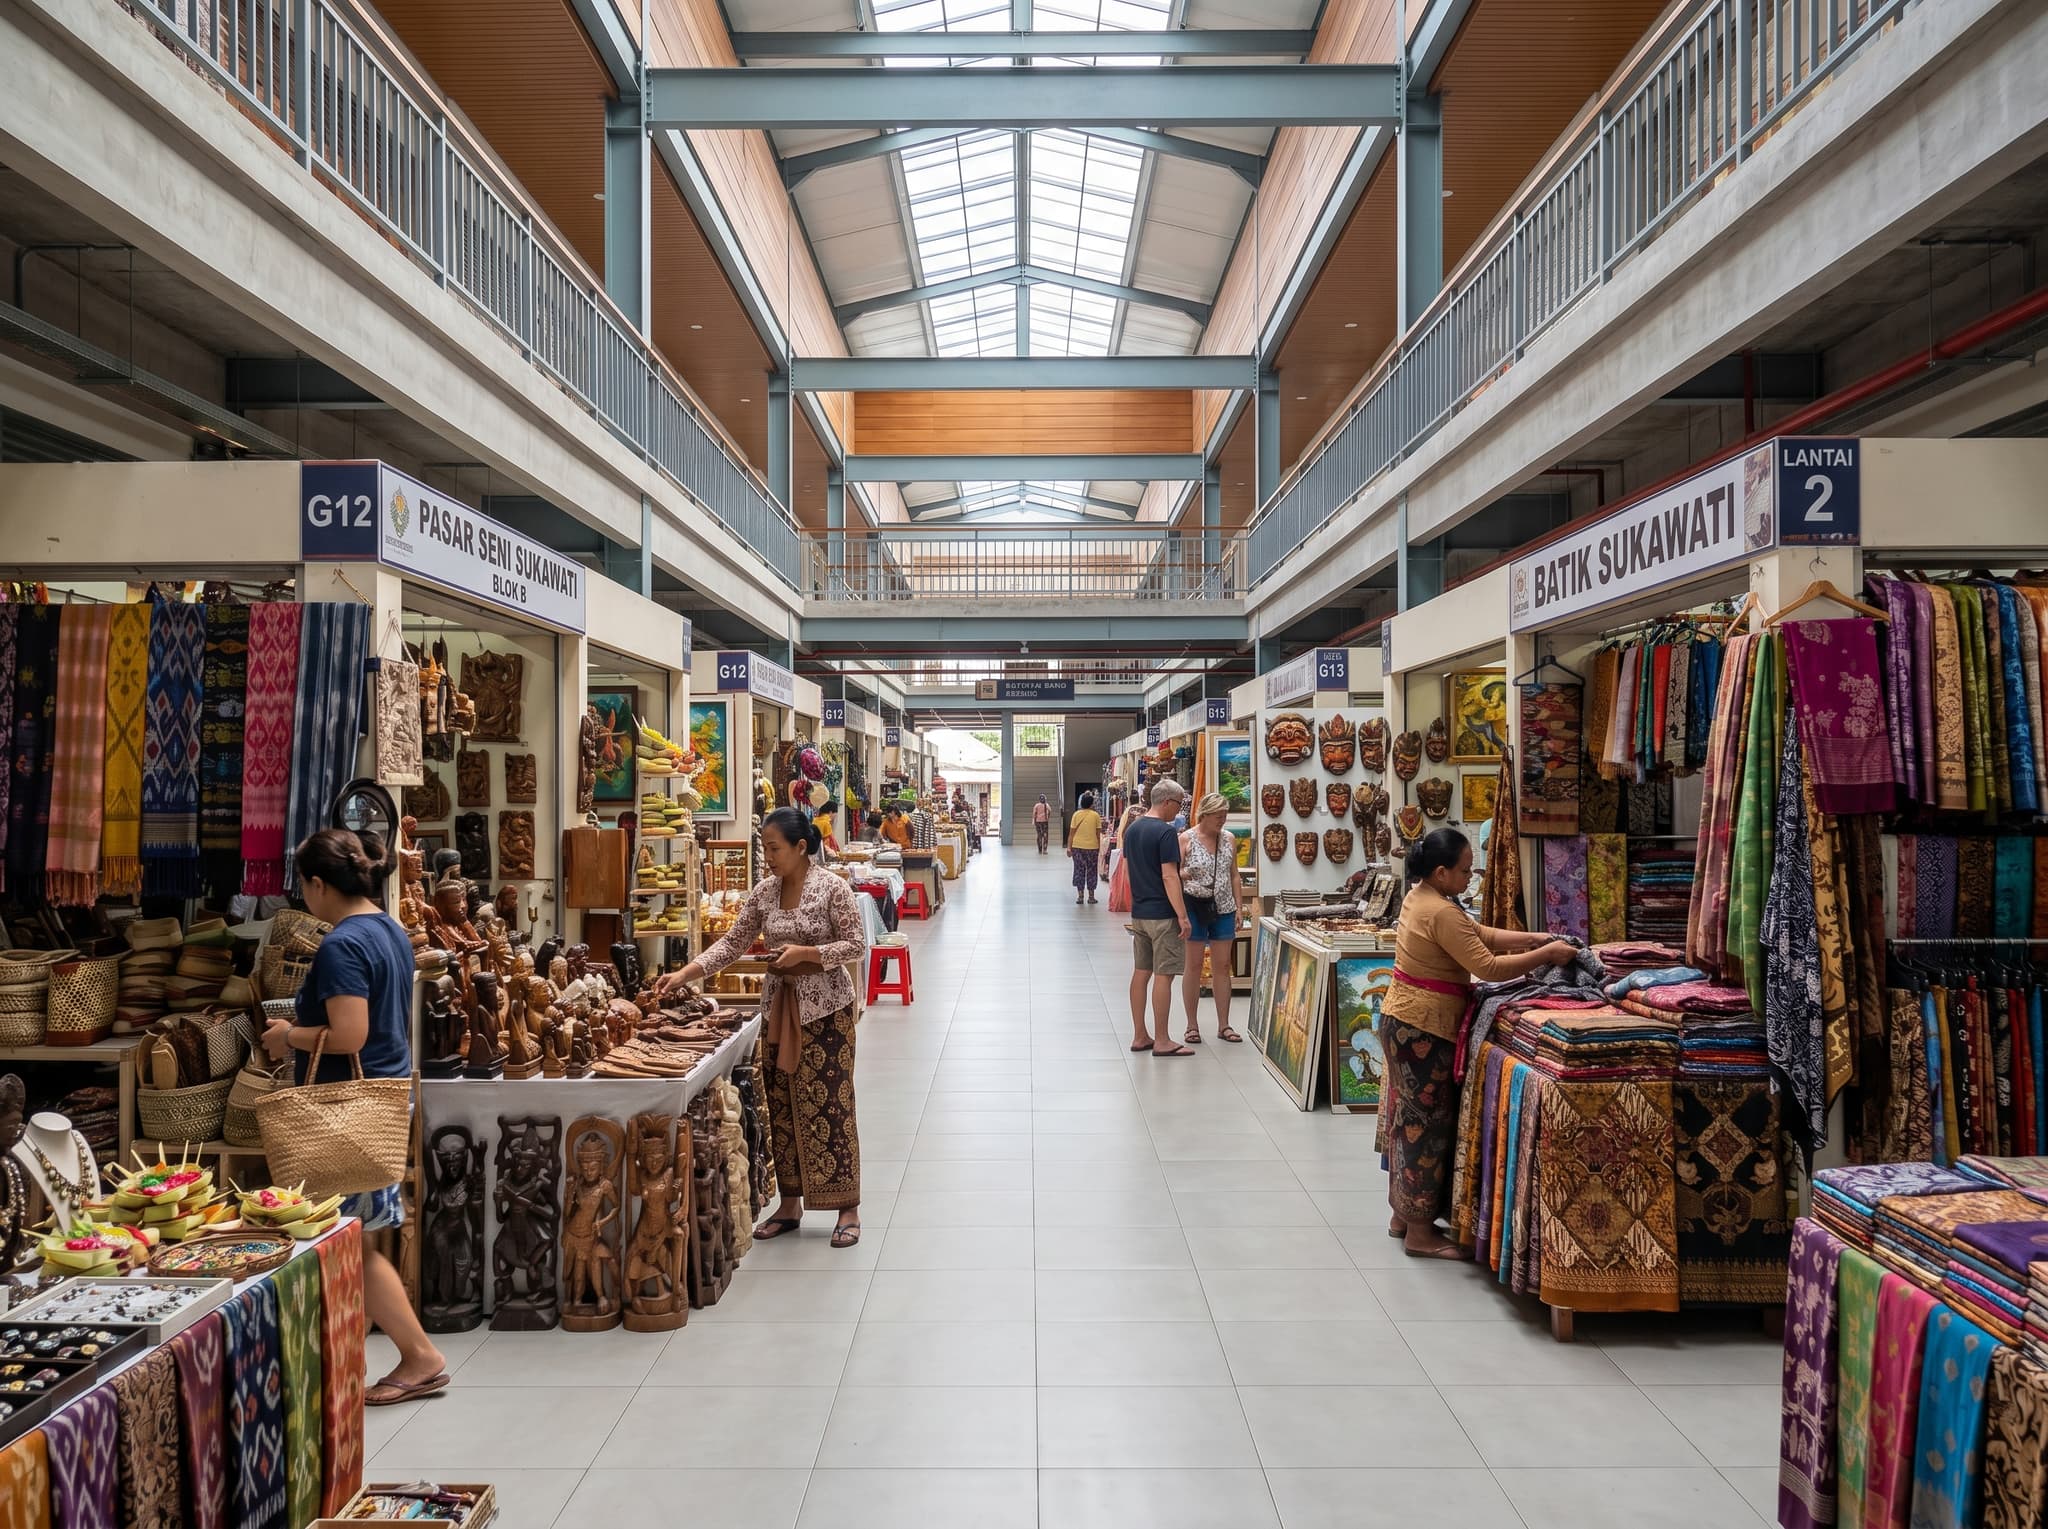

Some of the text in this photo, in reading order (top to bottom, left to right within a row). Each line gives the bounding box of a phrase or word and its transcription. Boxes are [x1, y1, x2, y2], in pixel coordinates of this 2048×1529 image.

[1783, 448, 1853, 467] LANTAI
[307, 494, 372, 528] G12
[1803, 474, 1834, 522] 2
[419, 498, 578, 600] PASAR SENI SUKAWATI
[1534, 482, 1735, 608] BATIK SUKAWATI
[492, 572, 527, 604] BLOK B
[719, 664, 747, 679] G12
[1319, 663, 1345, 678] G13
[825, 708, 844, 720] G12
